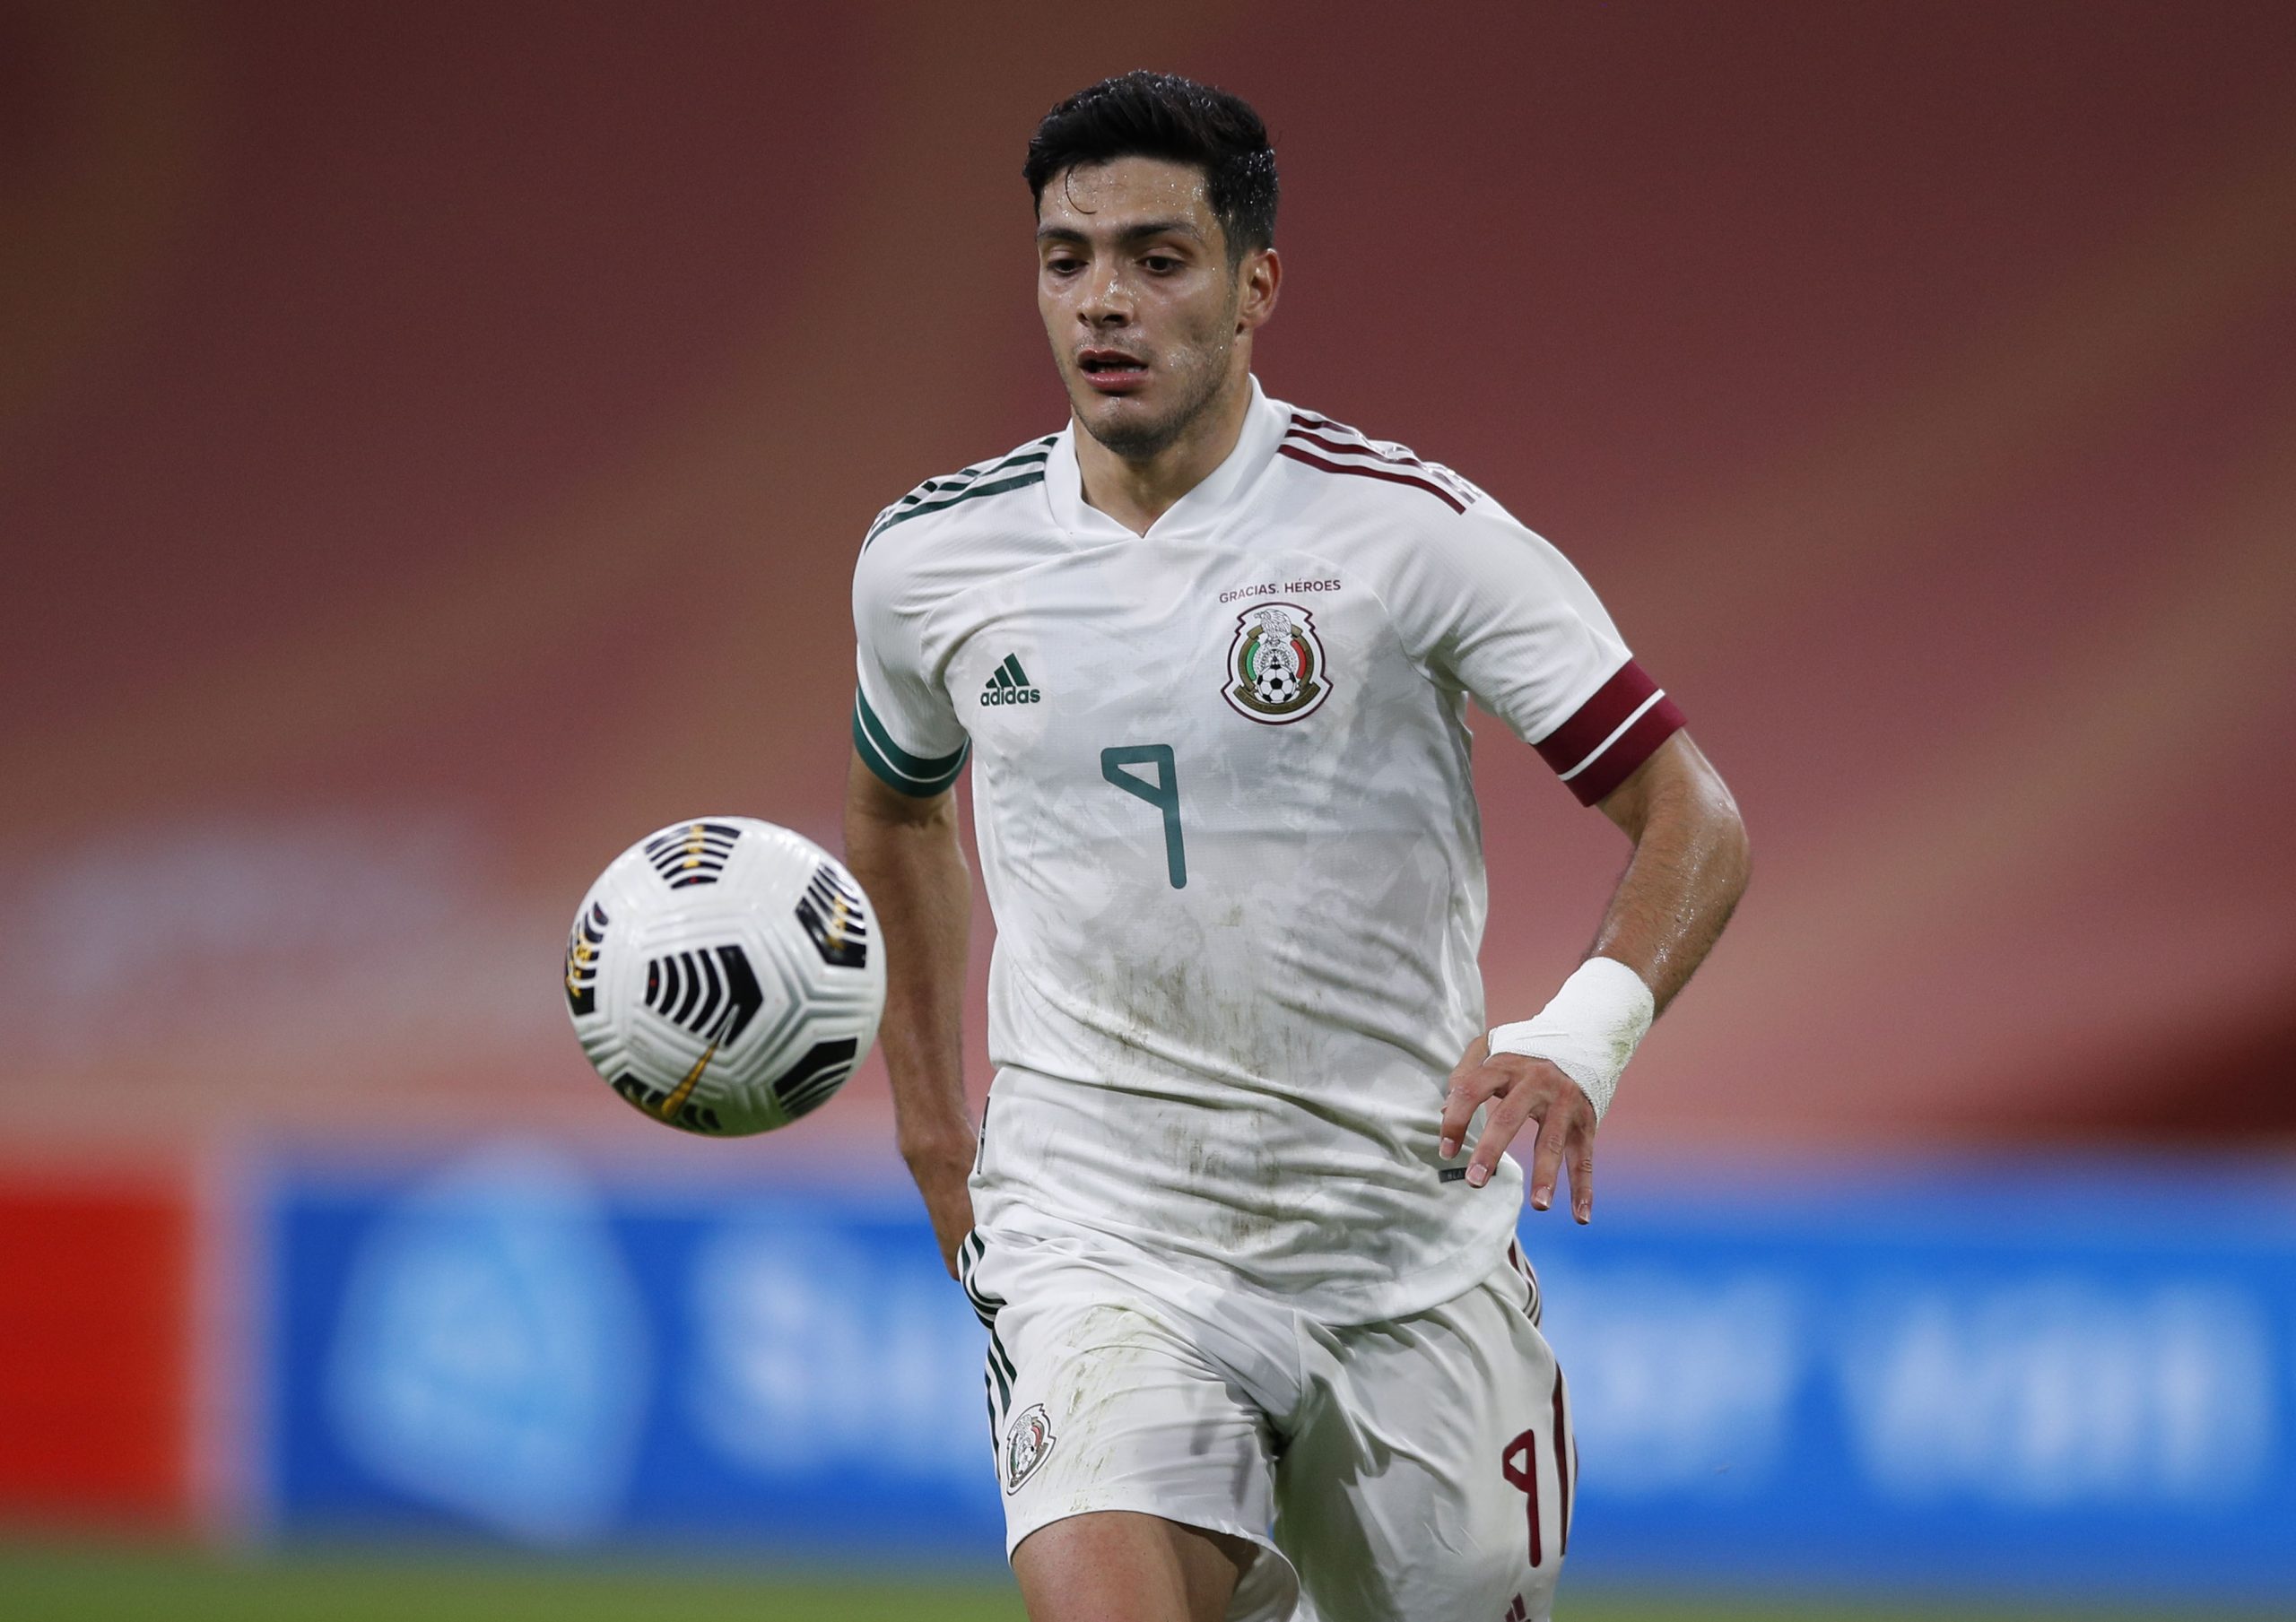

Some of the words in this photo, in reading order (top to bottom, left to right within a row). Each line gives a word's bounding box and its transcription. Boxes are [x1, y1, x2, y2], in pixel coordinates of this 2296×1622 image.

[980, 687, 1041, 707] adidas
[1100, 743, 1187, 889] 9
[1501, 1428, 1543, 1568] 9
